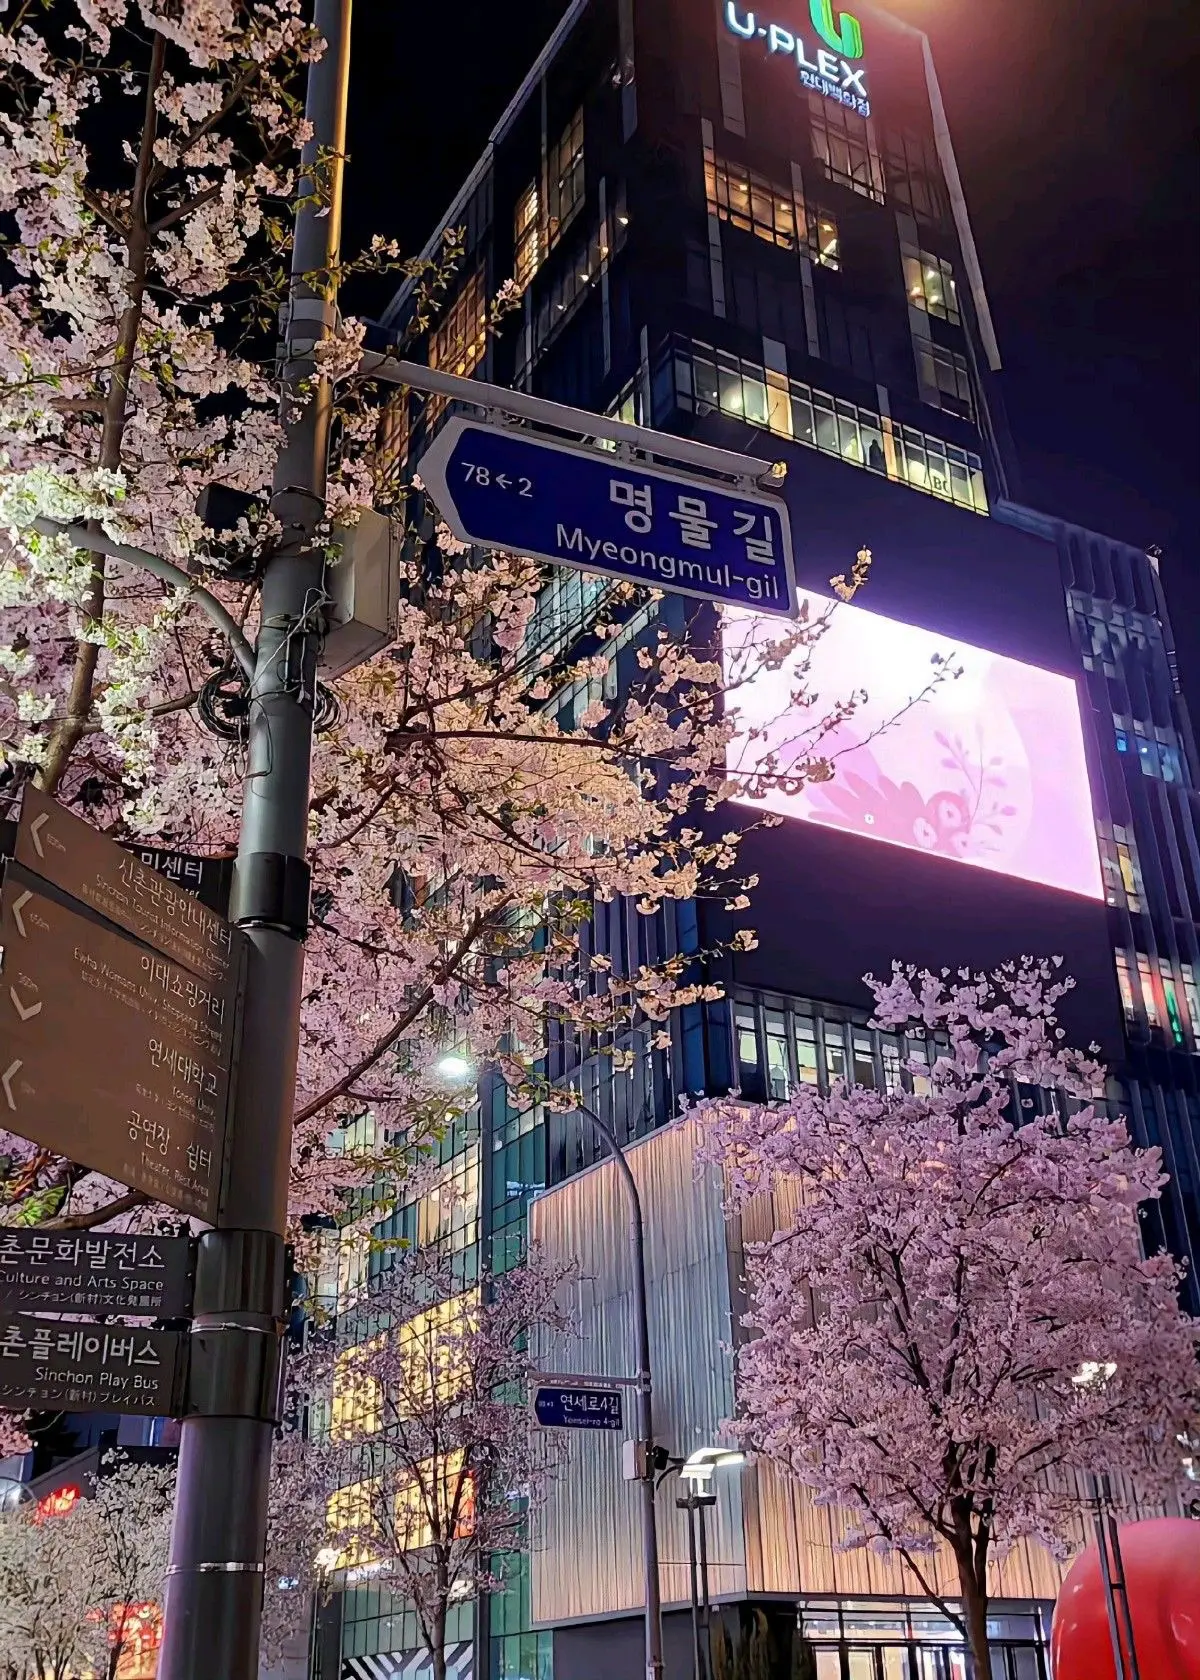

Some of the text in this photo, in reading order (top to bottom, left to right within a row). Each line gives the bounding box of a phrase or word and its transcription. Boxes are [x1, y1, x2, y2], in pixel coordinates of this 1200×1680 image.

[460, 462, 533, 498] 78 2
[609, 478, 776, 566] 명물길
[556, 523, 778, 599] Myeongmul-gil
[118, 858, 232, 955] 신촌관광안내센터
[141, 956, 225, 1025] 이대쇼핑거리
[149, 1039, 218, 1097] 연세대학교
[127, 1110, 212, 1178] 공연장 쉼터
[0, 1234, 165, 1271] 촌문화발전소
[55, 1274, 81, 1287] and
[87, 1276, 117, 1288] Arts
[121, 1277, 164, 1291] Space
[0, 1325, 161, 1367] 촌플레이버스
[35, 1367, 159, 1390] Sinchon Play Bus
